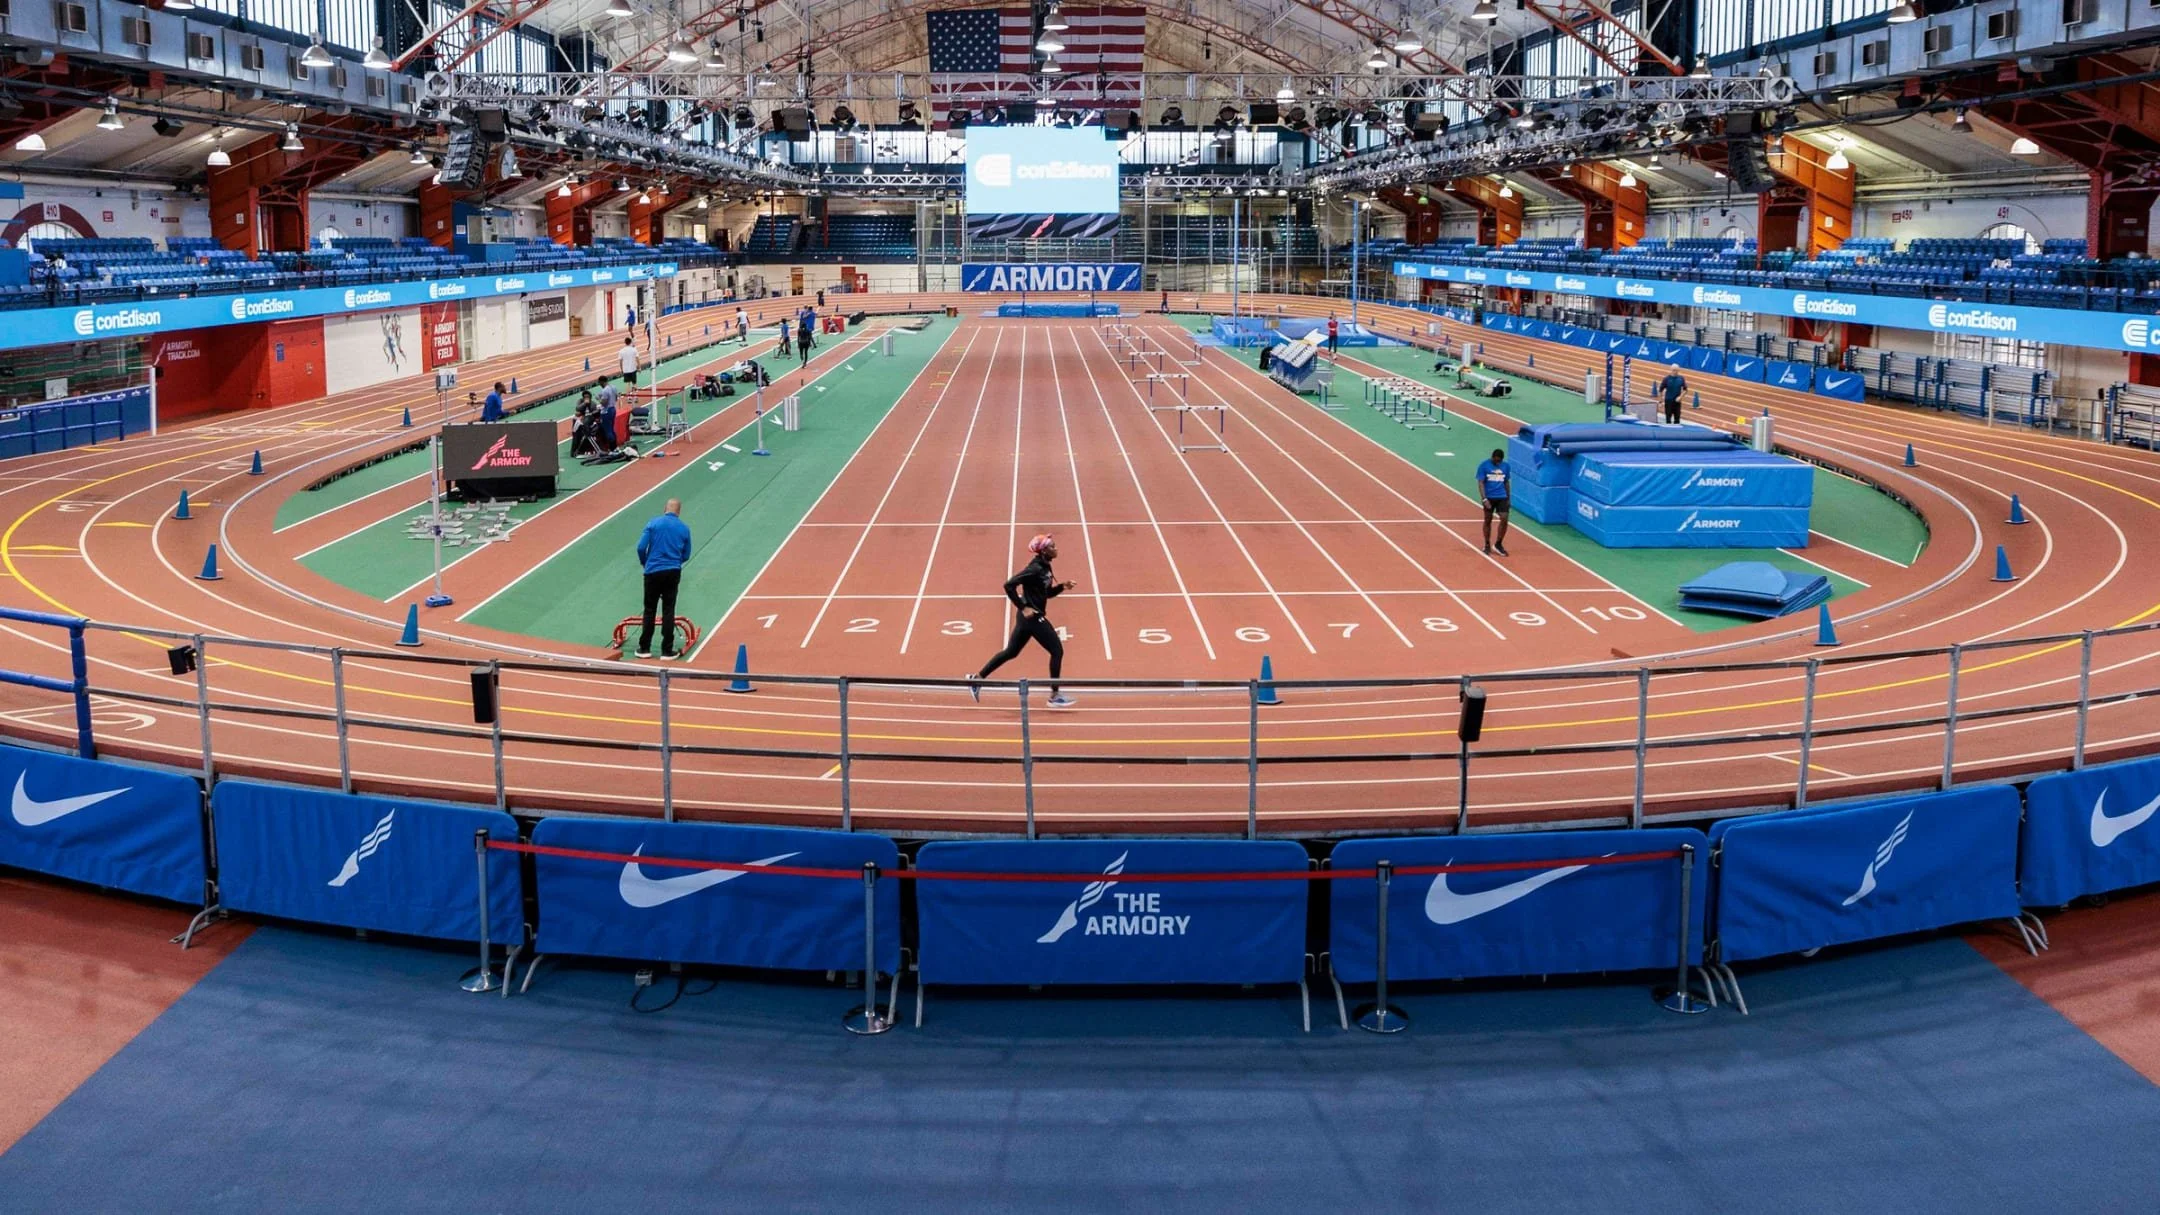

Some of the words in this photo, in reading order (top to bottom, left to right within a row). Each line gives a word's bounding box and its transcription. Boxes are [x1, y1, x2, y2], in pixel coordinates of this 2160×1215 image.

[1017, 161, 1112, 179] conEdison
[990, 266, 1115, 291] ARMORY
[1704, 289, 1741, 305] conEdison
[247, 298, 293, 316] conEdison
[1807, 298, 1857, 317] conEdison
[96, 310, 161, 331] conEdison
[1948, 310, 2017, 332] conEdison
[167, 340, 193, 351] ARMORY
[434, 334, 452, 347] TRACK
[167, 349, 201, 361] TRACK.COM
[438, 346, 453, 360] FIELD
[501, 448, 520, 457] THE
[490, 456, 532, 467] ARMORY
[1697, 477, 1745, 487] ARMORY
[1693, 519, 1741, 529] ARMORY
[757, 613, 779, 629] 1
[1508, 611, 1547, 626] 9
[1580, 605, 1647, 621] 10
[844, 617, 880, 633] 2
[941, 620, 973, 636] 3
[1328, 622, 1360, 639] 7
[1421, 617, 1459, 633] 8
[1138, 628, 1172, 644] 5
[1235, 626, 1271, 643] 6
[1114, 893, 1161, 913] THE
[1085, 915, 1191, 936] ARMORY
